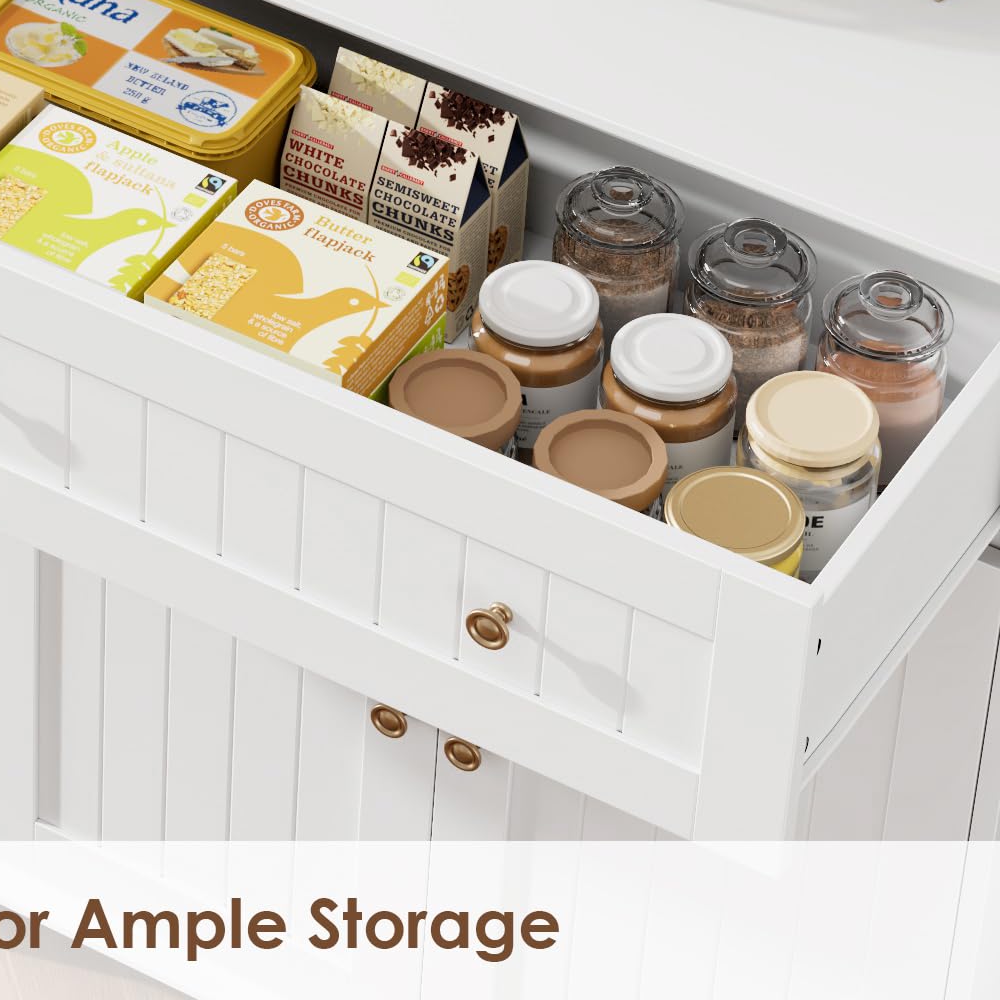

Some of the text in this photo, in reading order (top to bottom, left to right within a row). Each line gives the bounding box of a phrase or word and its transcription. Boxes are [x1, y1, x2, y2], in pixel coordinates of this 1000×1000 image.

[42, 122, 76, 139] DOVES
[105, 137, 159, 165] Apple
[289, 137, 345, 170] WHITE
[83, 161, 154, 196] flapjack
[112, 158, 176, 190] sultana
[283, 164, 364, 206] CHUNKS
[285, 151, 367, 192] CHOCOLATE
[248, 199, 300, 221] DOVES FARM
[374, 189, 458, 229] CHOCOLATE
[376, 175, 460, 215] SEMISWEET
[248, 213, 292, 231] ORGANIC
[314, 214, 374, 246] Butter
[371, 201, 455, 243] CHUNKS
[373, 218, 451, 252] PREMIUM CHOCOLATE FOR
[228, 245, 246, 257] bars
[303, 227, 376, 263] flapjack
[253, 312, 294, 333] wholegrain
[261, 325, 288, 339] source
[272, 311, 285, 322] low
[267, 334, 285, 347] fibre
